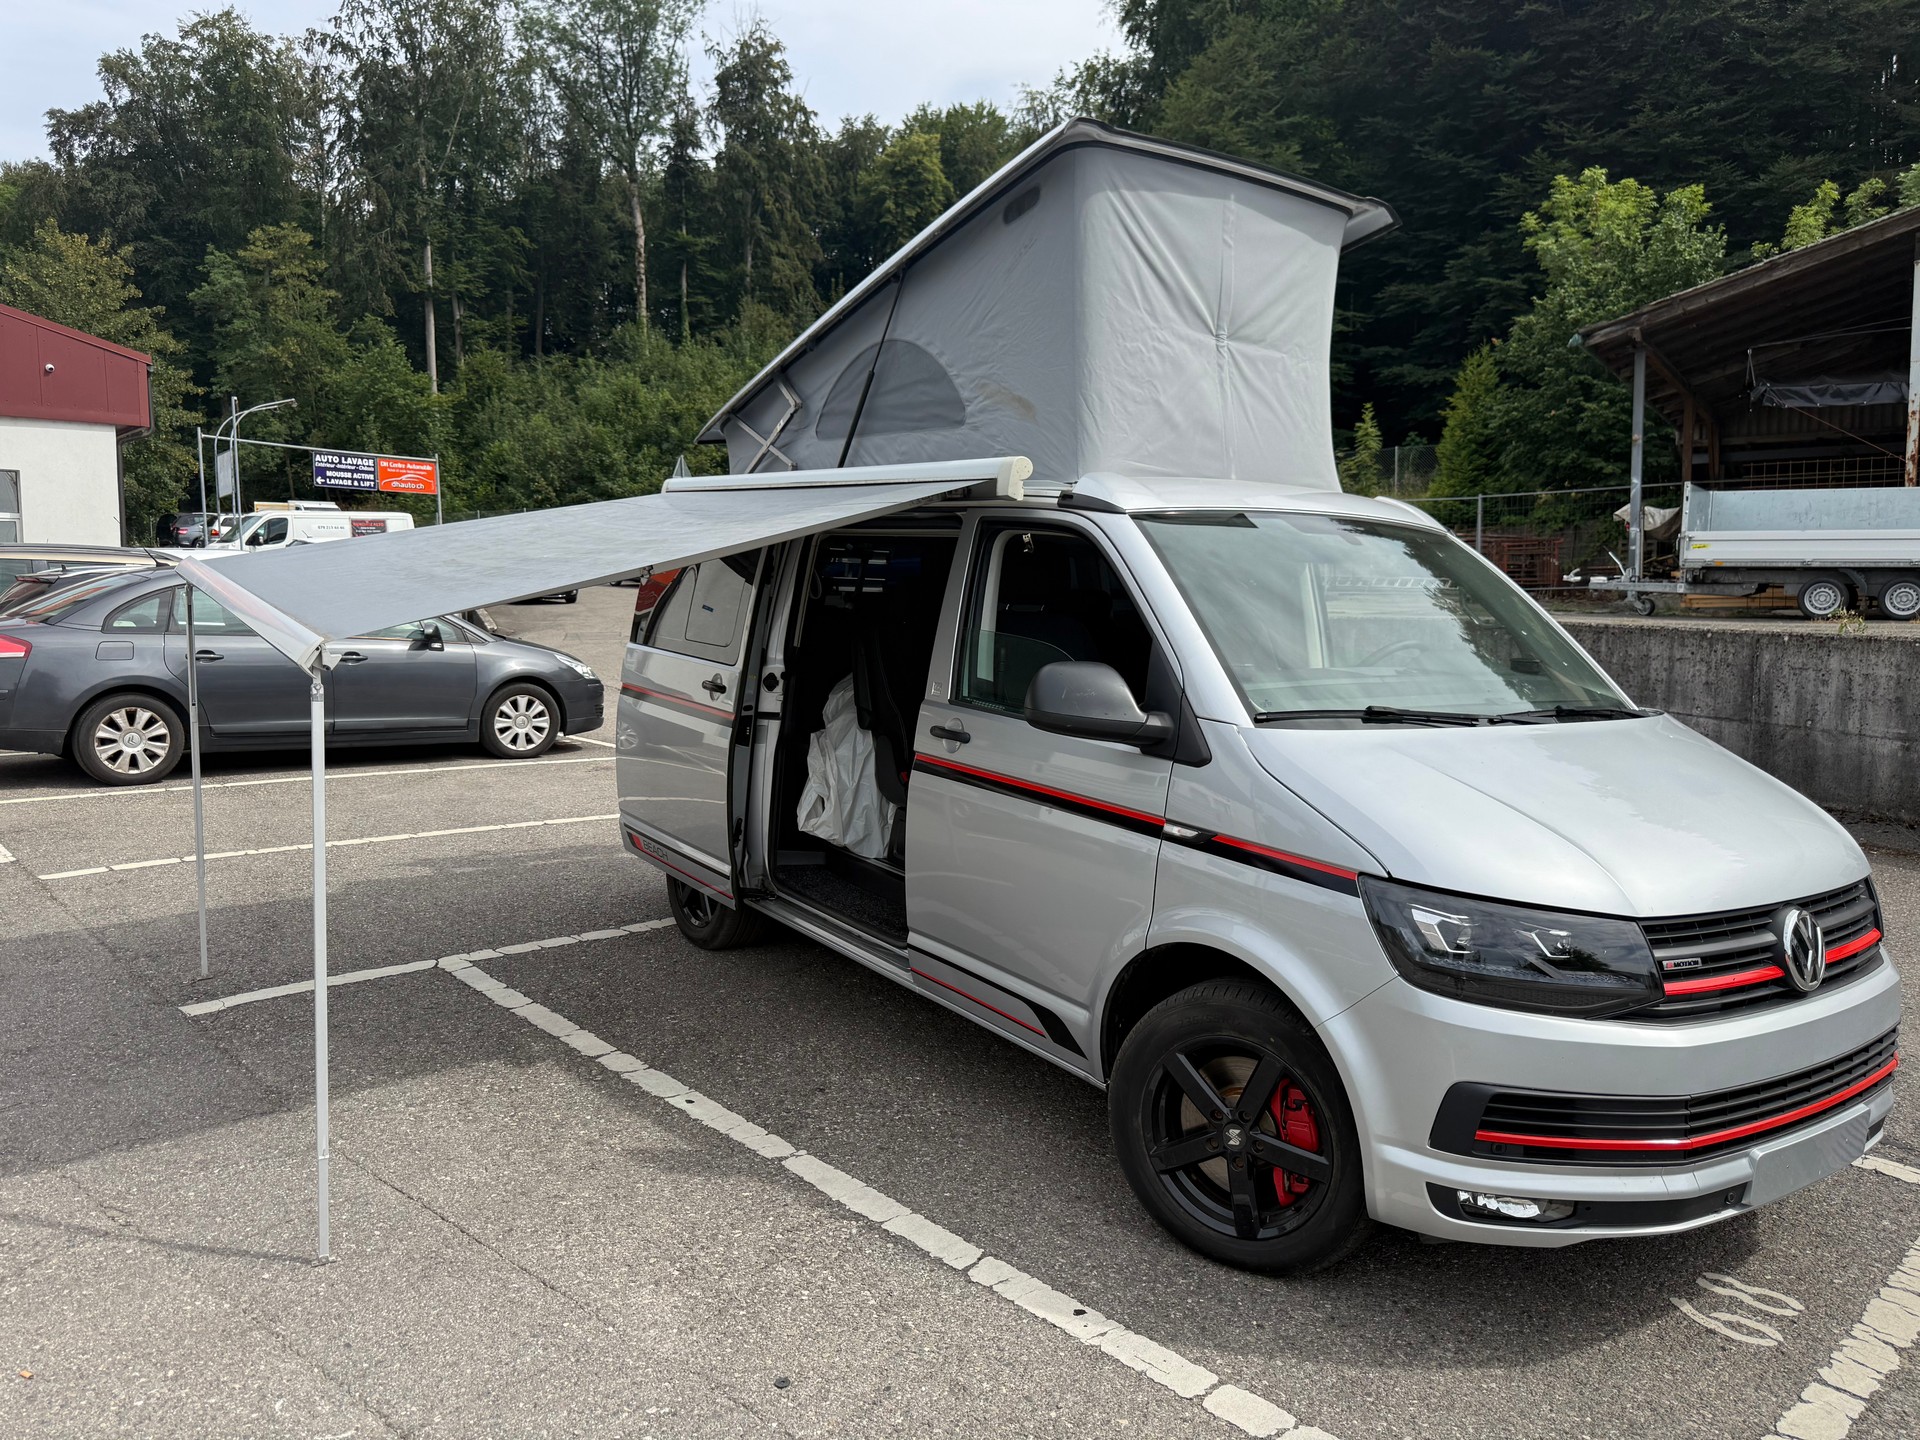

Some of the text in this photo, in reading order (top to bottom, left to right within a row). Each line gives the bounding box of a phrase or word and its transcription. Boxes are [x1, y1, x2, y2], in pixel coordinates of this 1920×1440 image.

[315, 454, 375, 466] AUTO LAVAGE
[391, 481, 425, 489] dhauto.ch
[642, 839, 669, 861] BEACH
